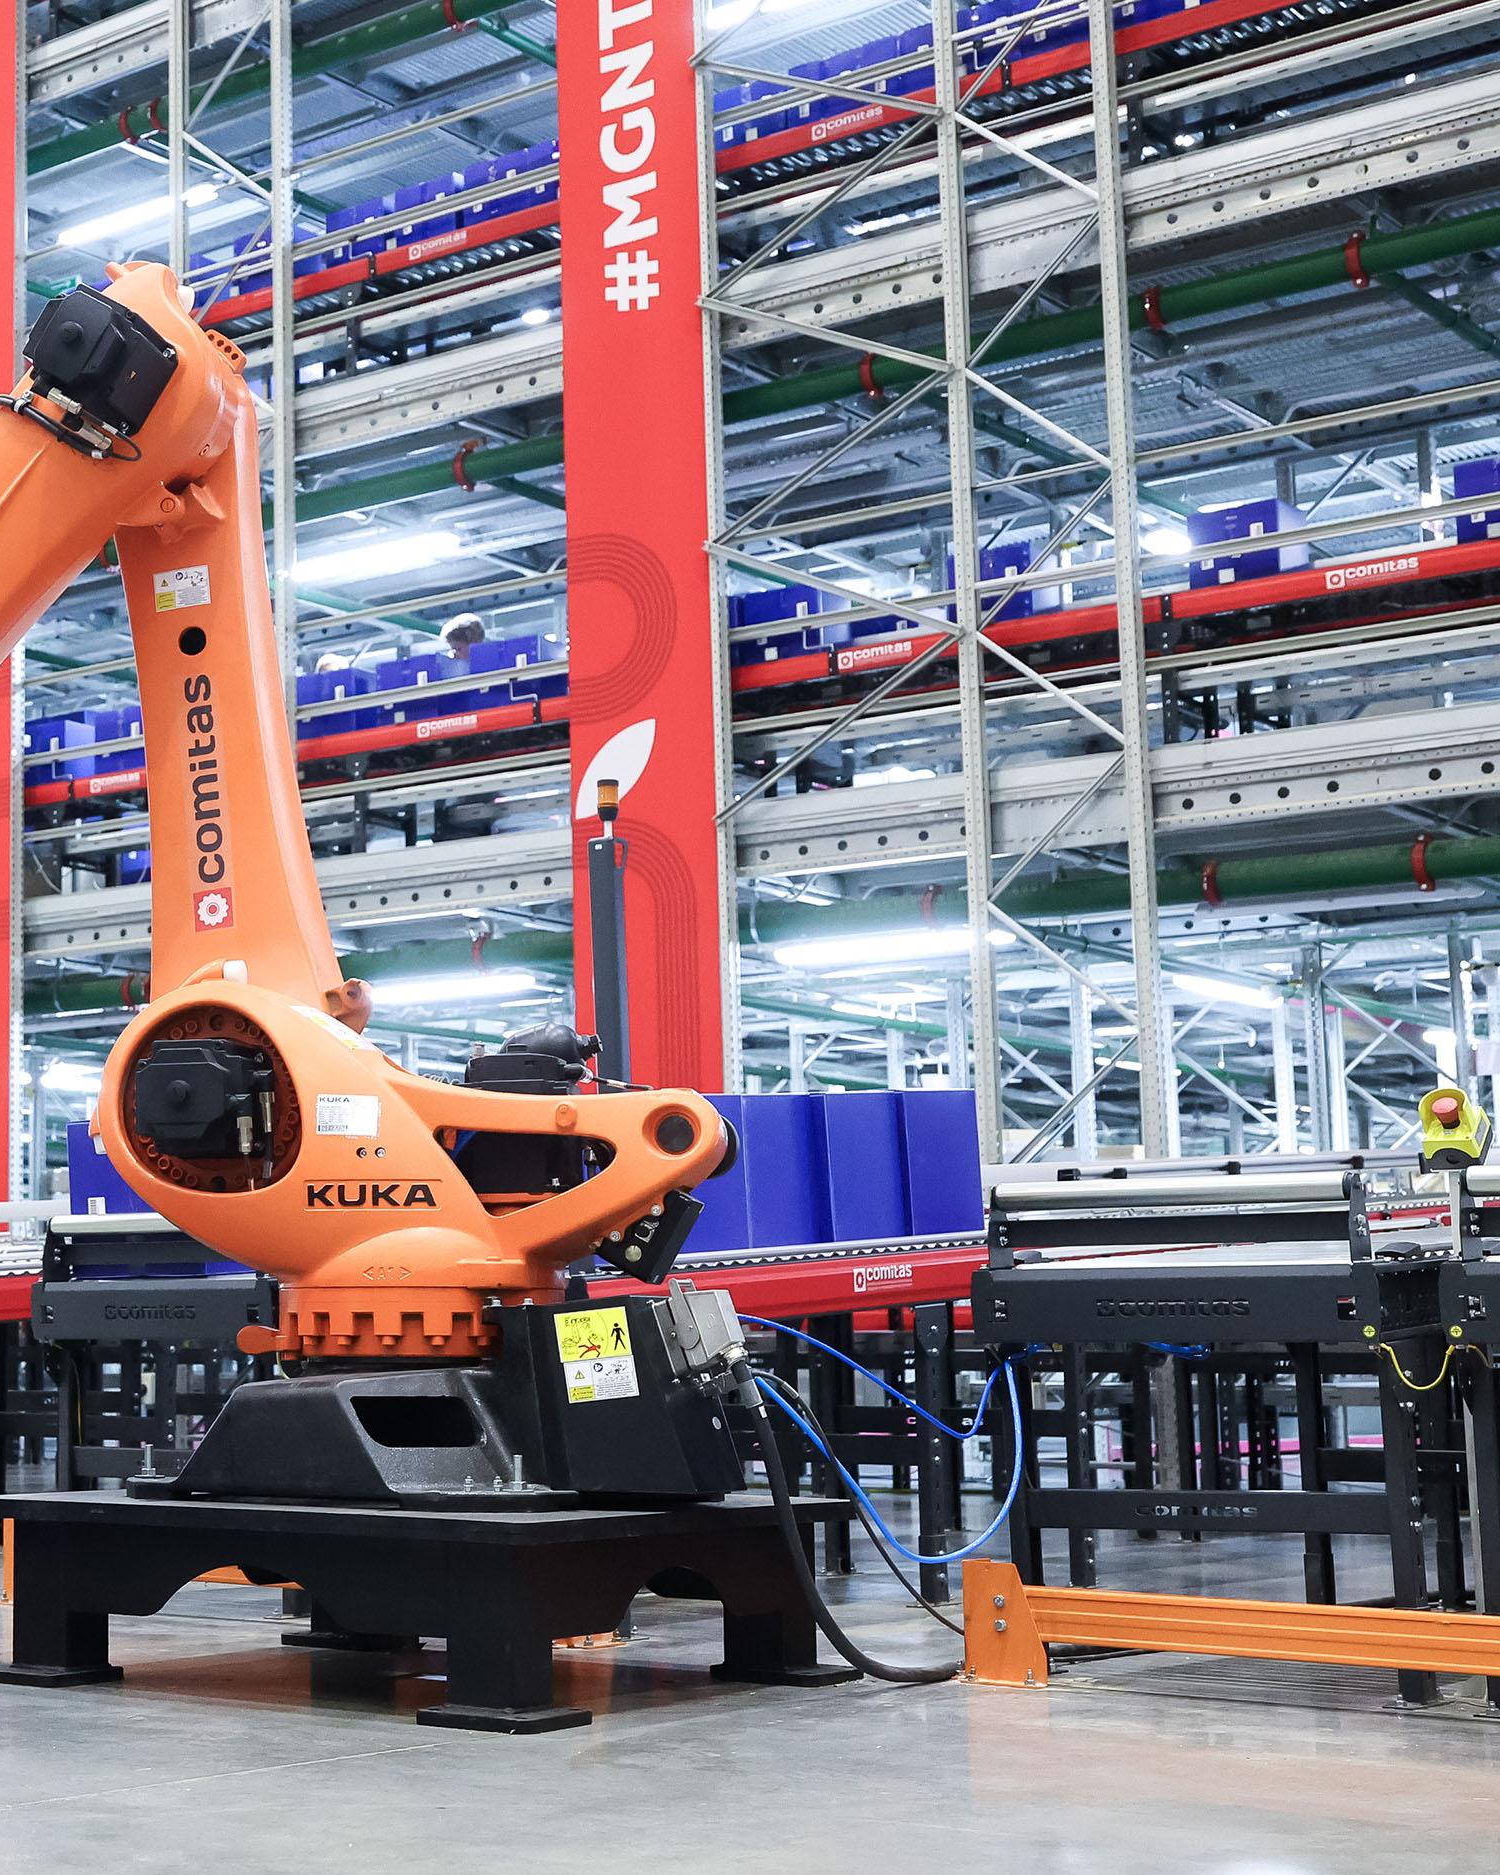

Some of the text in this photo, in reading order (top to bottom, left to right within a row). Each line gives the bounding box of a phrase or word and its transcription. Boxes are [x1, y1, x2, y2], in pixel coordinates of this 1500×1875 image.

[826, 105, 883, 130] comitas
[1345, 557, 1419, 579] comitas
[853, 641, 912, 660] comitas
[184, 674, 225, 883] comitas
[307, 1184, 437, 1207] KUKA
[866, 1264, 912, 1281] comitas
[118, 1305, 196, 1320] comitas
[1118, 1300, 1250, 1318] comitas
